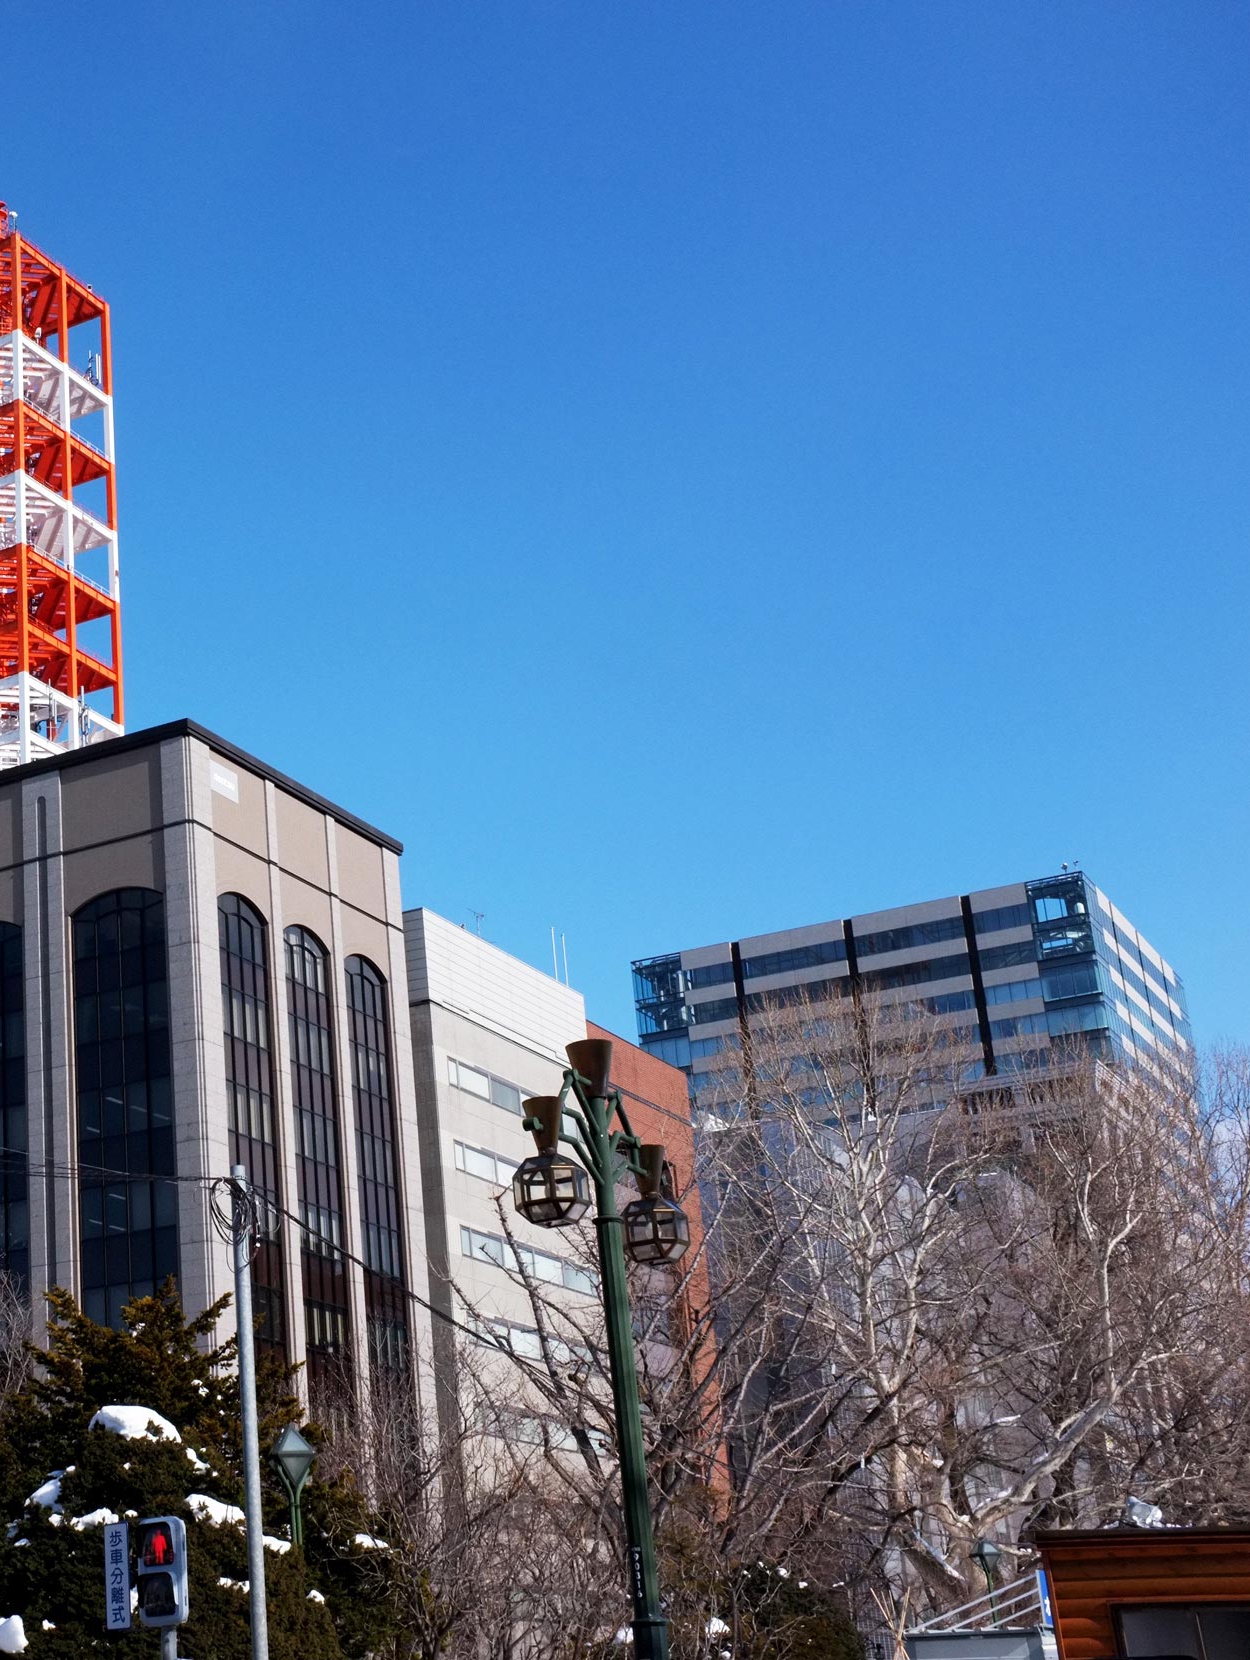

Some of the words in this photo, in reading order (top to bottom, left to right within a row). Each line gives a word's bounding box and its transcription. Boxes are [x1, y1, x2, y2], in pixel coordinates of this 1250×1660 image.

[109, 1530, 125, 1624] 歩車分離式
